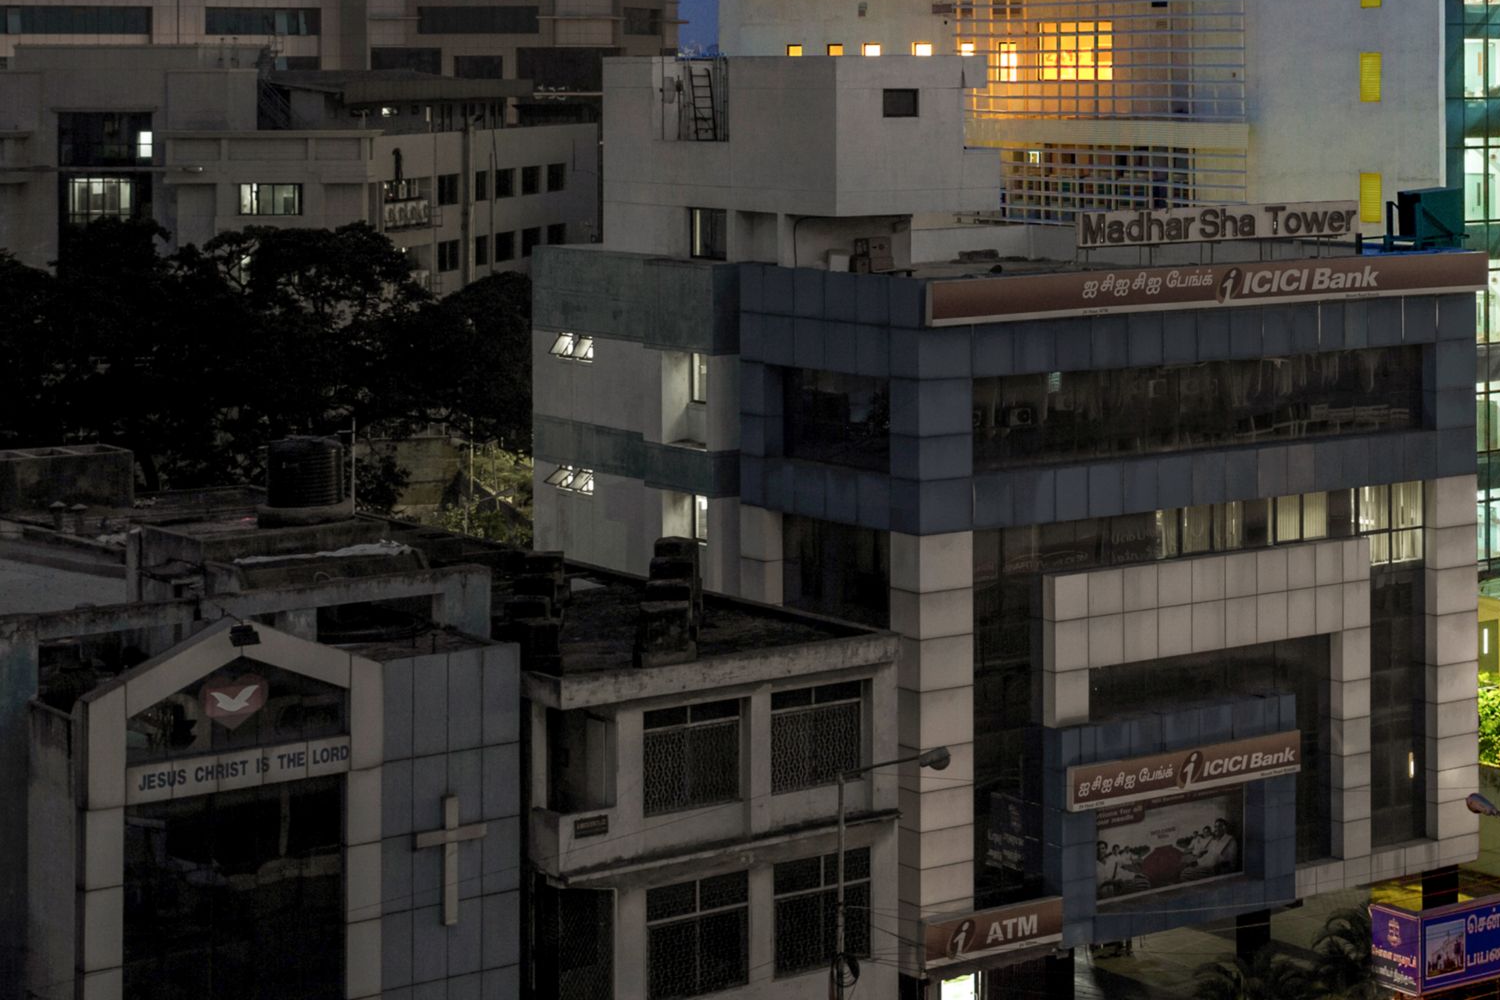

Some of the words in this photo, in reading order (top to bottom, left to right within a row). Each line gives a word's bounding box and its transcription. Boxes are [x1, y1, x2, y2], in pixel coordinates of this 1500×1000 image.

[1082, 210, 1196, 245] Madhar
[1200, 208, 1256, 239] Sha
[1265, 204, 1358, 235] Tower
[1242, 269, 1308, 295] ICICI
[1312, 265, 1379, 291] Bank
[138, 769, 187, 792] JESUS
[194, 760, 248, 783] CHRIST
[256, 756, 270, 773] IS
[278, 751, 306, 770] THE
[312, 744, 350, 766] LORD
[1203, 754, 1247, 777] ICICI
[1249, 746, 1295, 768] Bank
[985, 914, 1038, 945] ATM
